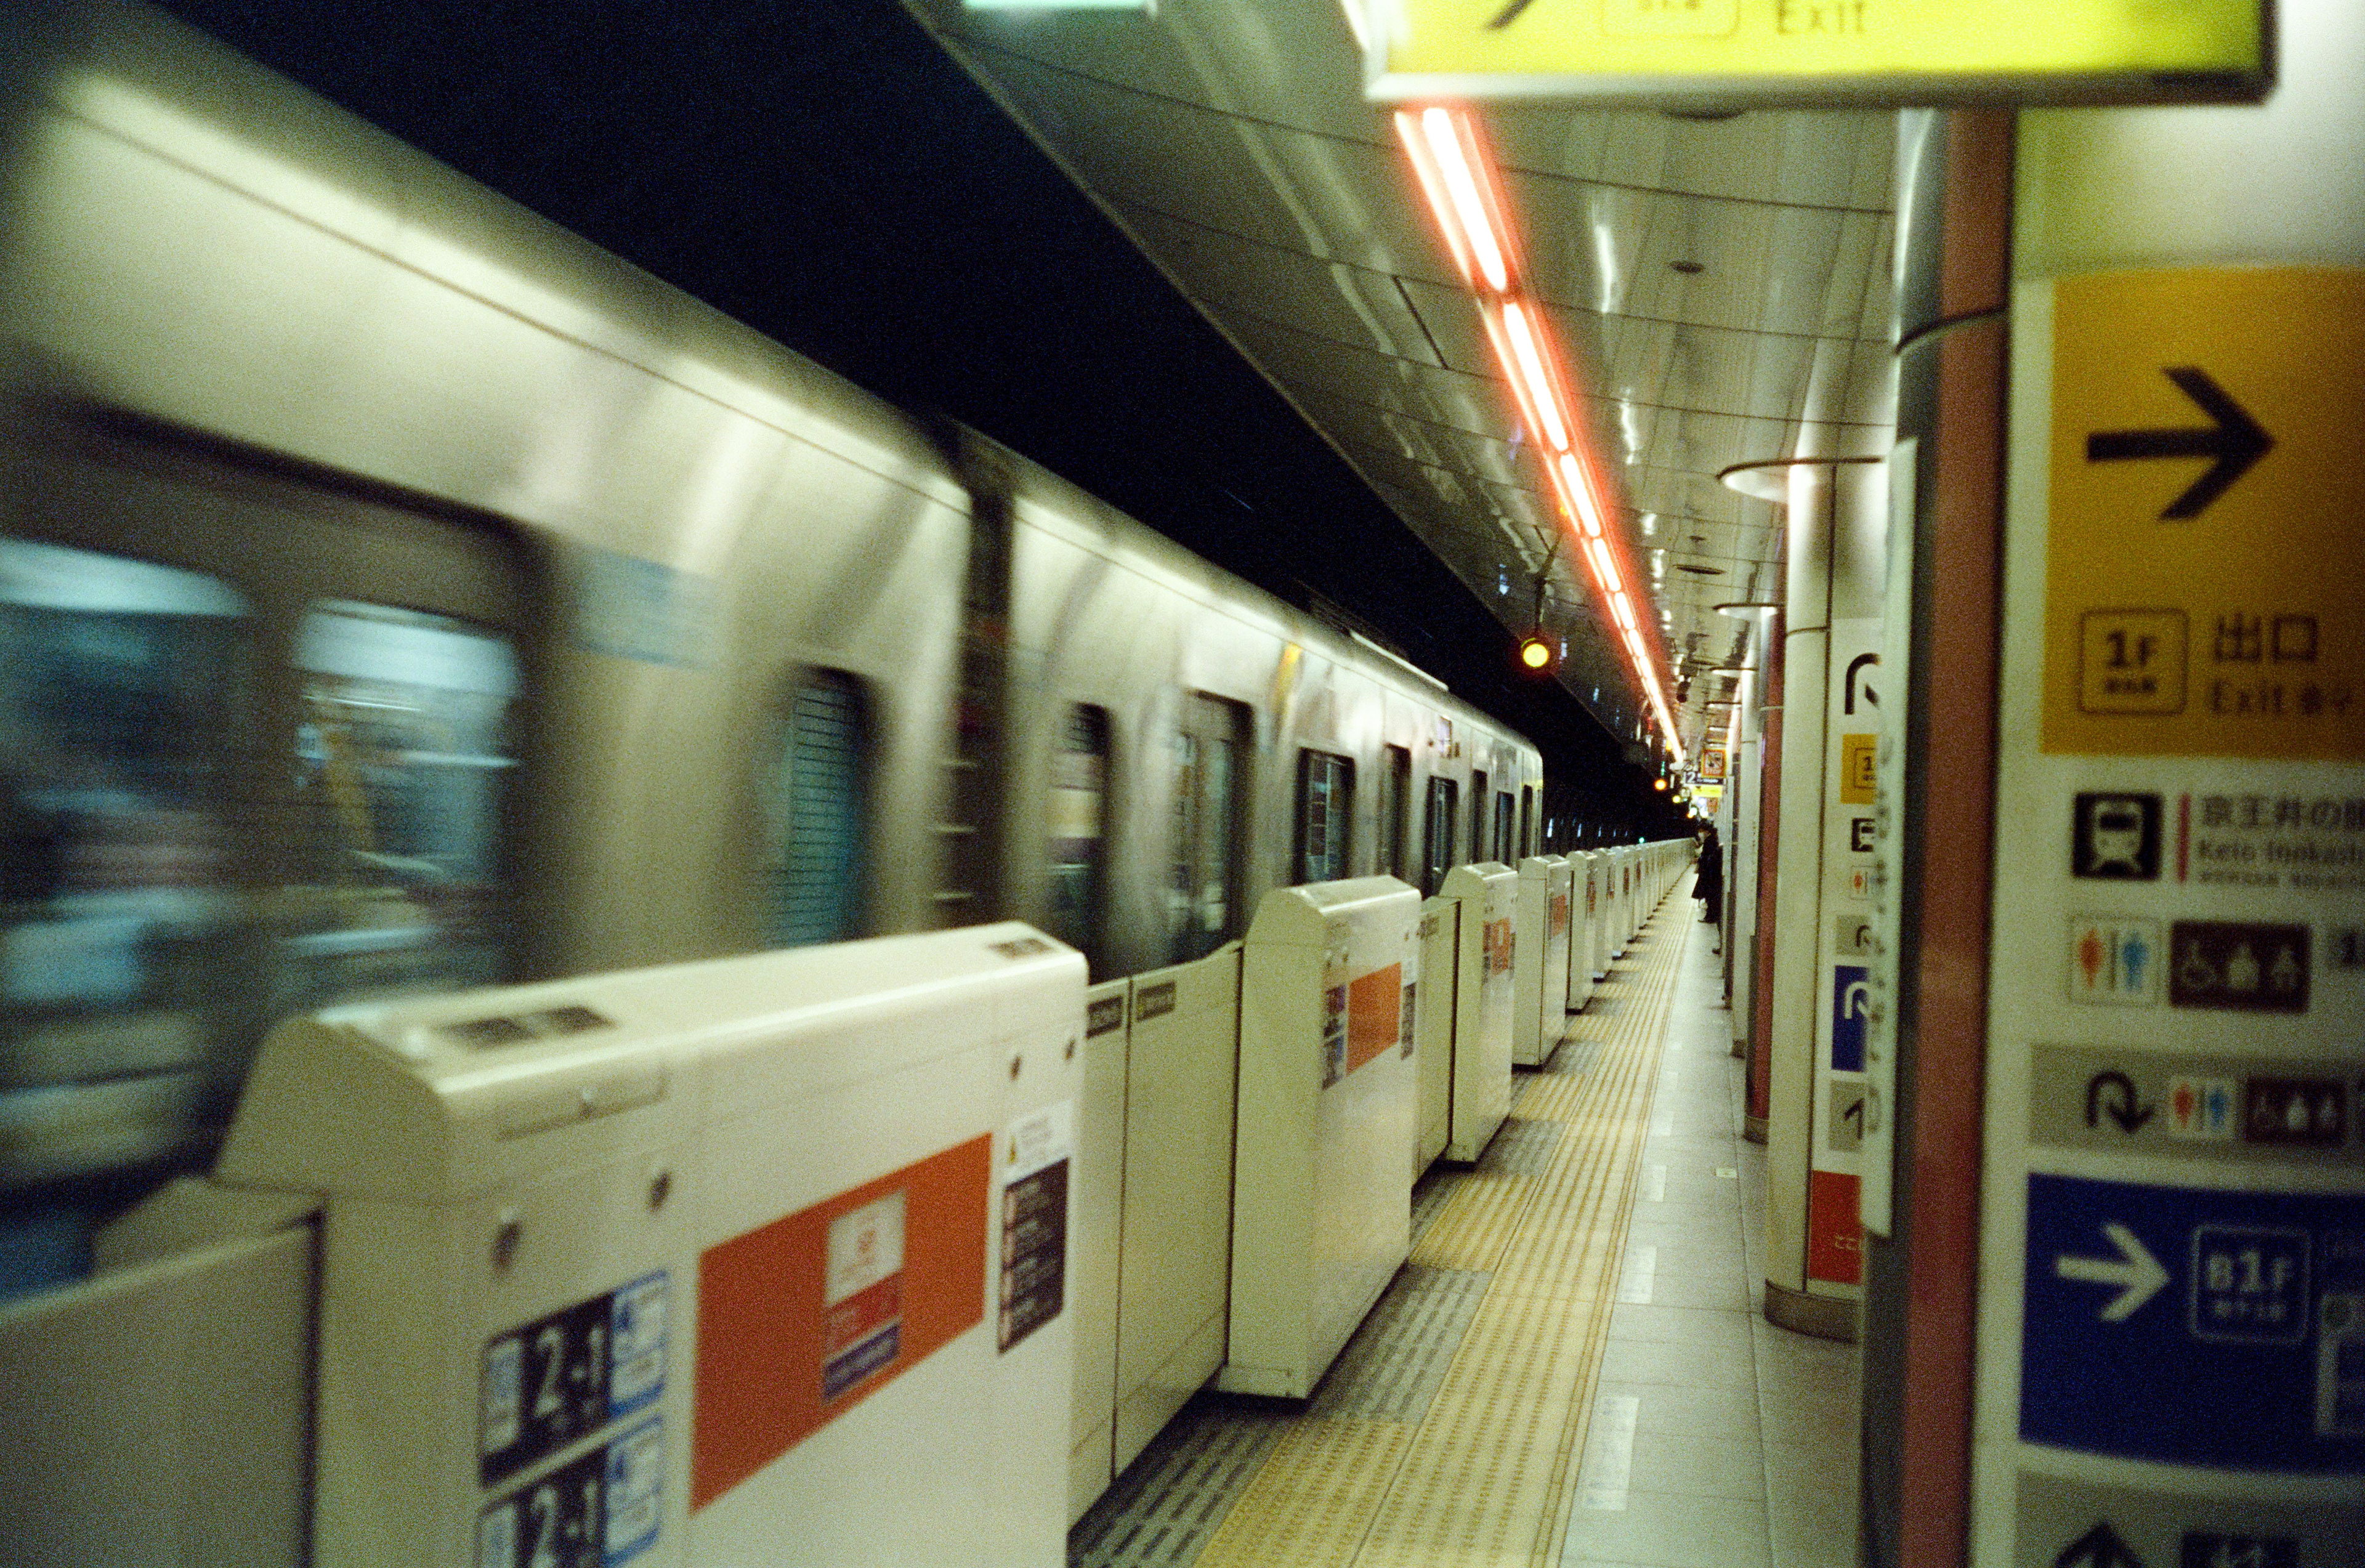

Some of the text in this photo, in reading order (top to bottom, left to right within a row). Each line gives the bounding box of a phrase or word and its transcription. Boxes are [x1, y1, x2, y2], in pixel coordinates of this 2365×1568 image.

[1775, 0, 1866, 35] Exit
[2106, 628, 2156, 669] 1F
[2213, 612, 2319, 664] 出口
[2211, 679, 2285, 715] Exit
